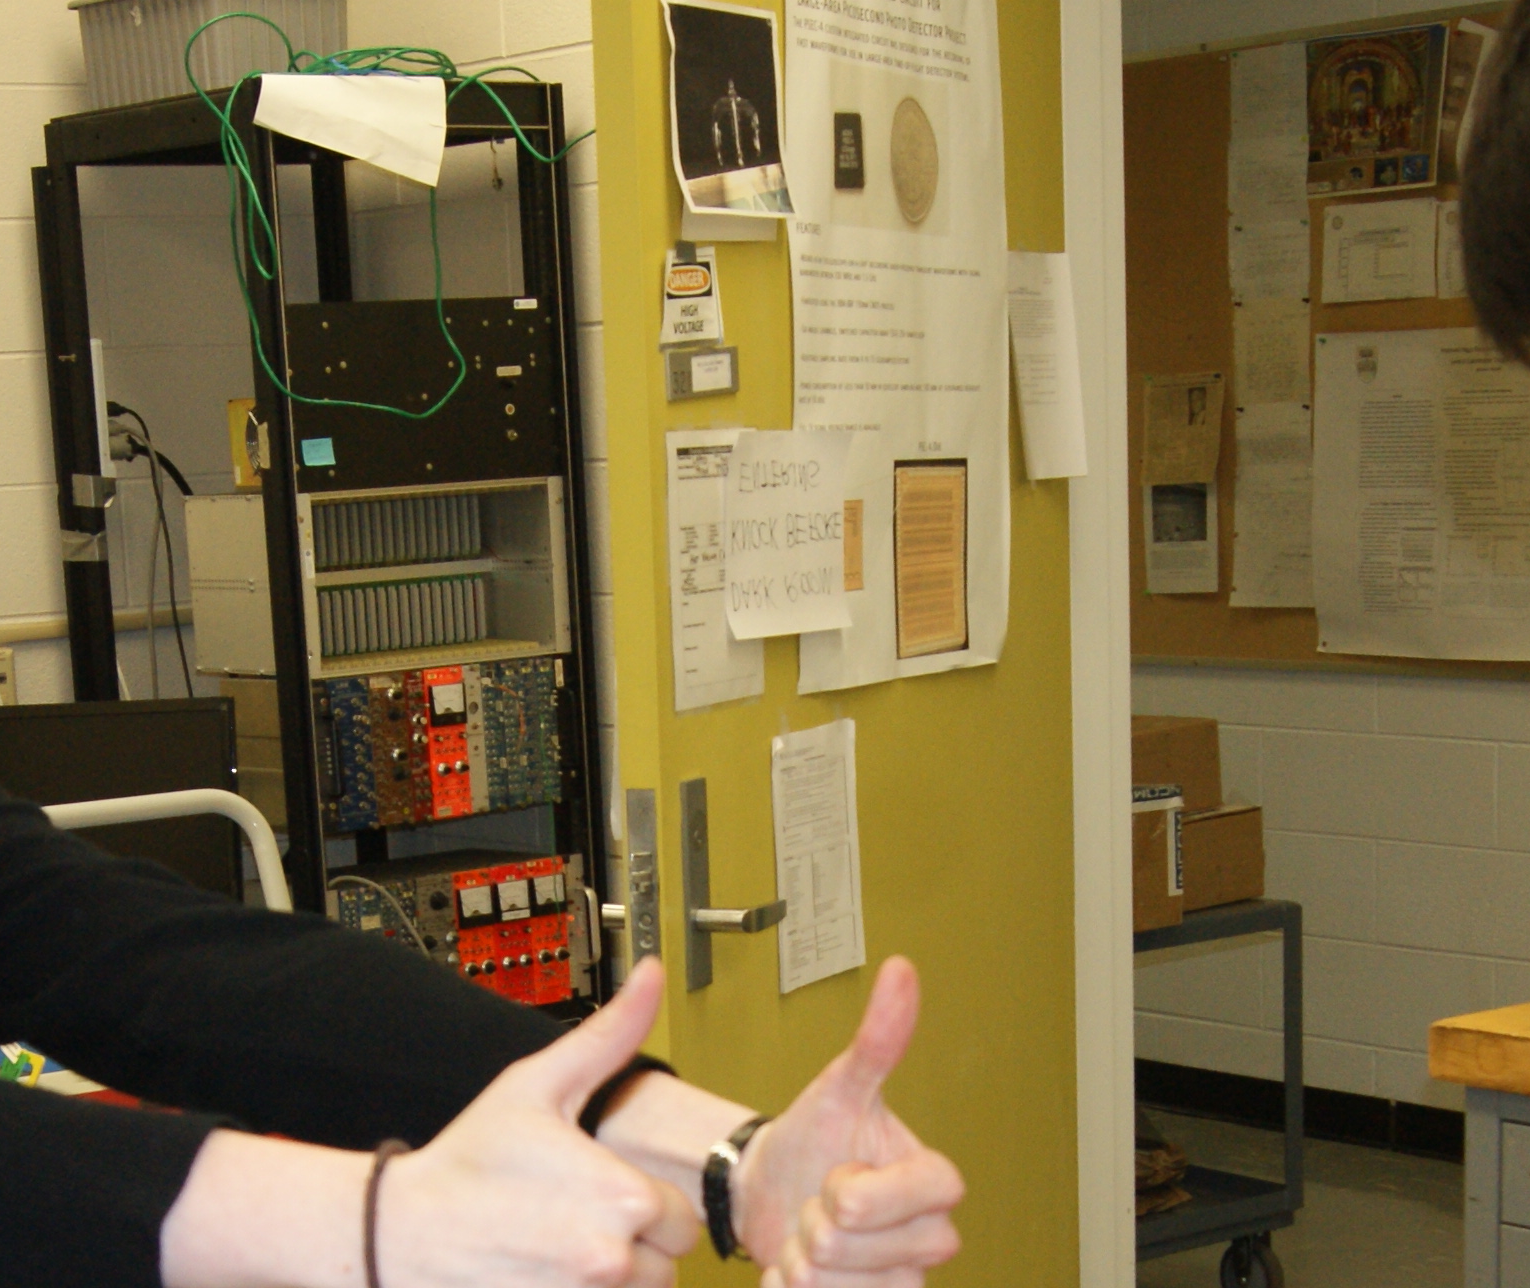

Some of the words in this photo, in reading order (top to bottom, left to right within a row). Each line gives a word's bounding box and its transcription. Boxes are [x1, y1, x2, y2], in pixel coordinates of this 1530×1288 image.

[908, 17, 943, 38] DETECTOR
[670, 270, 705, 290] DANGER
[680, 303, 699, 318] HIGH
[673, 319, 705, 335] VOLTAGE
